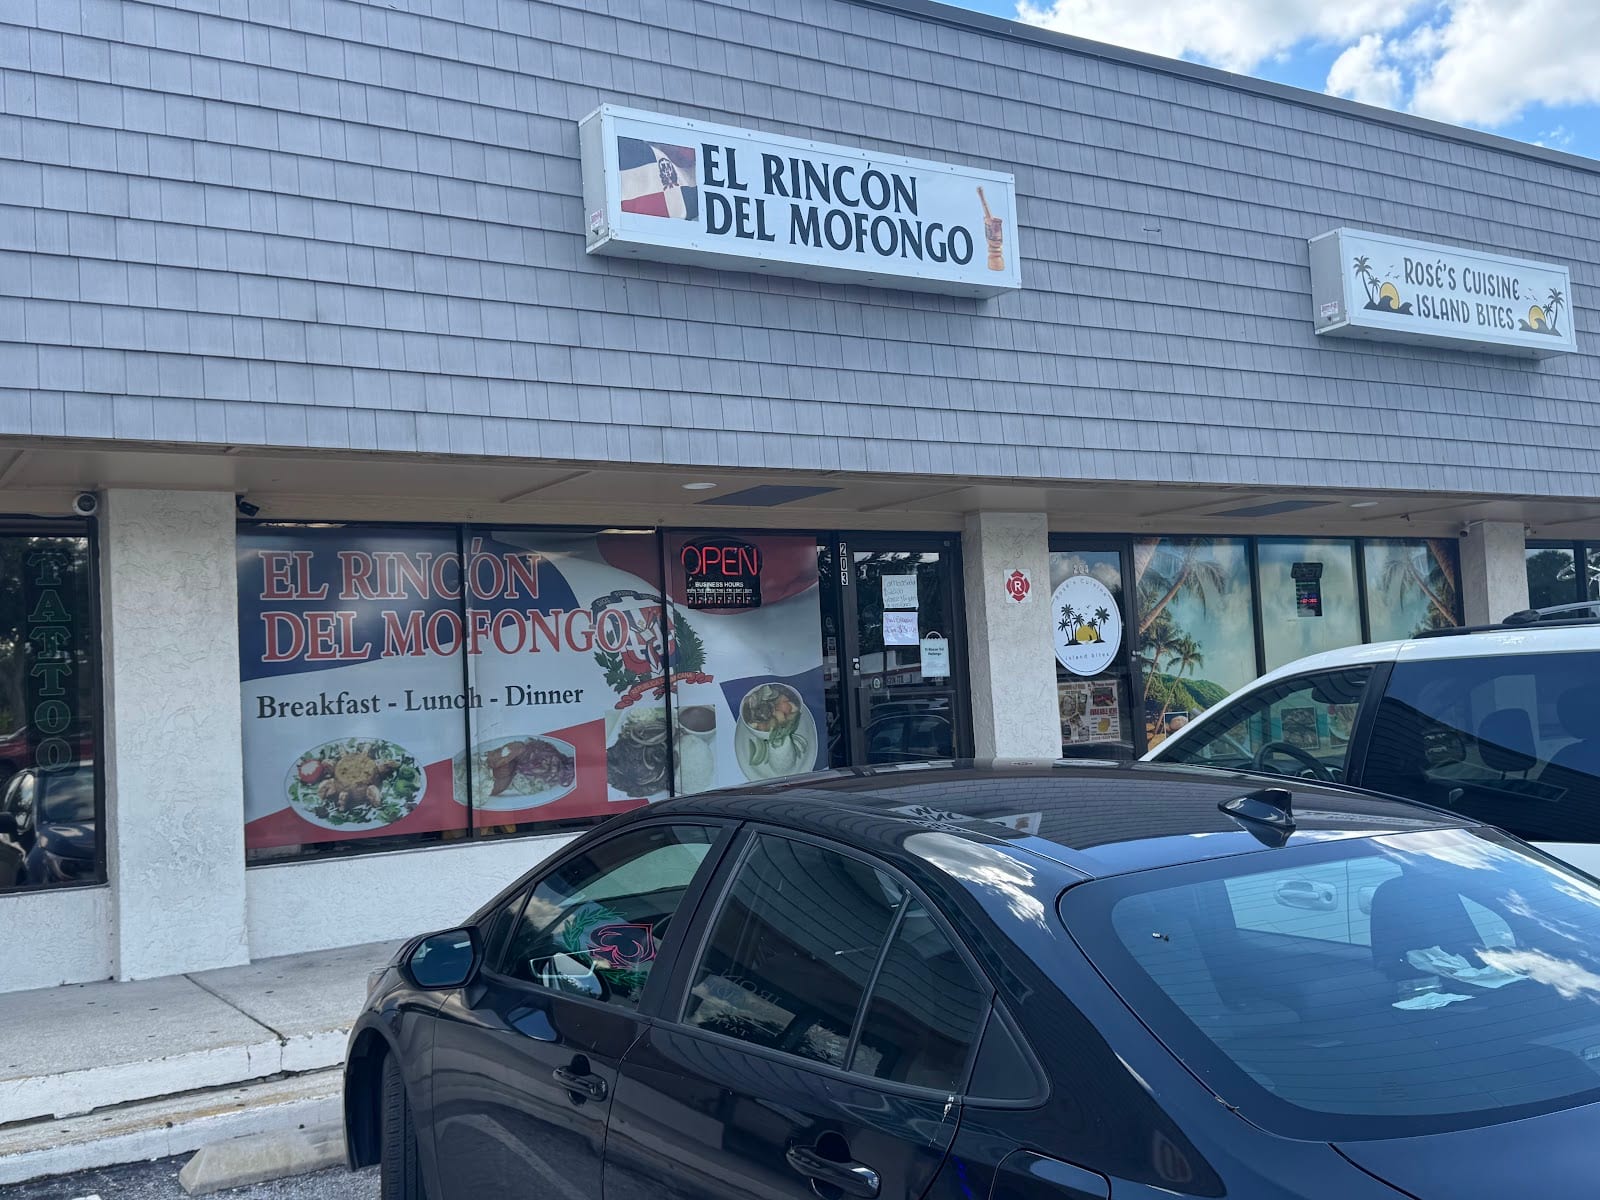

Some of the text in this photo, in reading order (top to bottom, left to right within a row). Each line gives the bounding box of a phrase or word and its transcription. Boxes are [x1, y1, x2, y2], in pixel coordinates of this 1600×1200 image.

[701, 143, 918, 216] EL RINCÓN
[704, 191, 974, 265] DEL MOFONGO
[258, 537, 542, 601] EL RINCÓN
[681, 545, 759, 576] OPEN
[840, 542, 849, 586] 203
[1013, 580, 1023, 592] R
[26, 551, 73, 772] TATTOO
[261, 608, 630, 663] DEL MOFONGO
[256, 692, 381, 719] Breakfast
[405, 686, 484, 713] Lunch
[505, 683, 585, 708] Dinner
